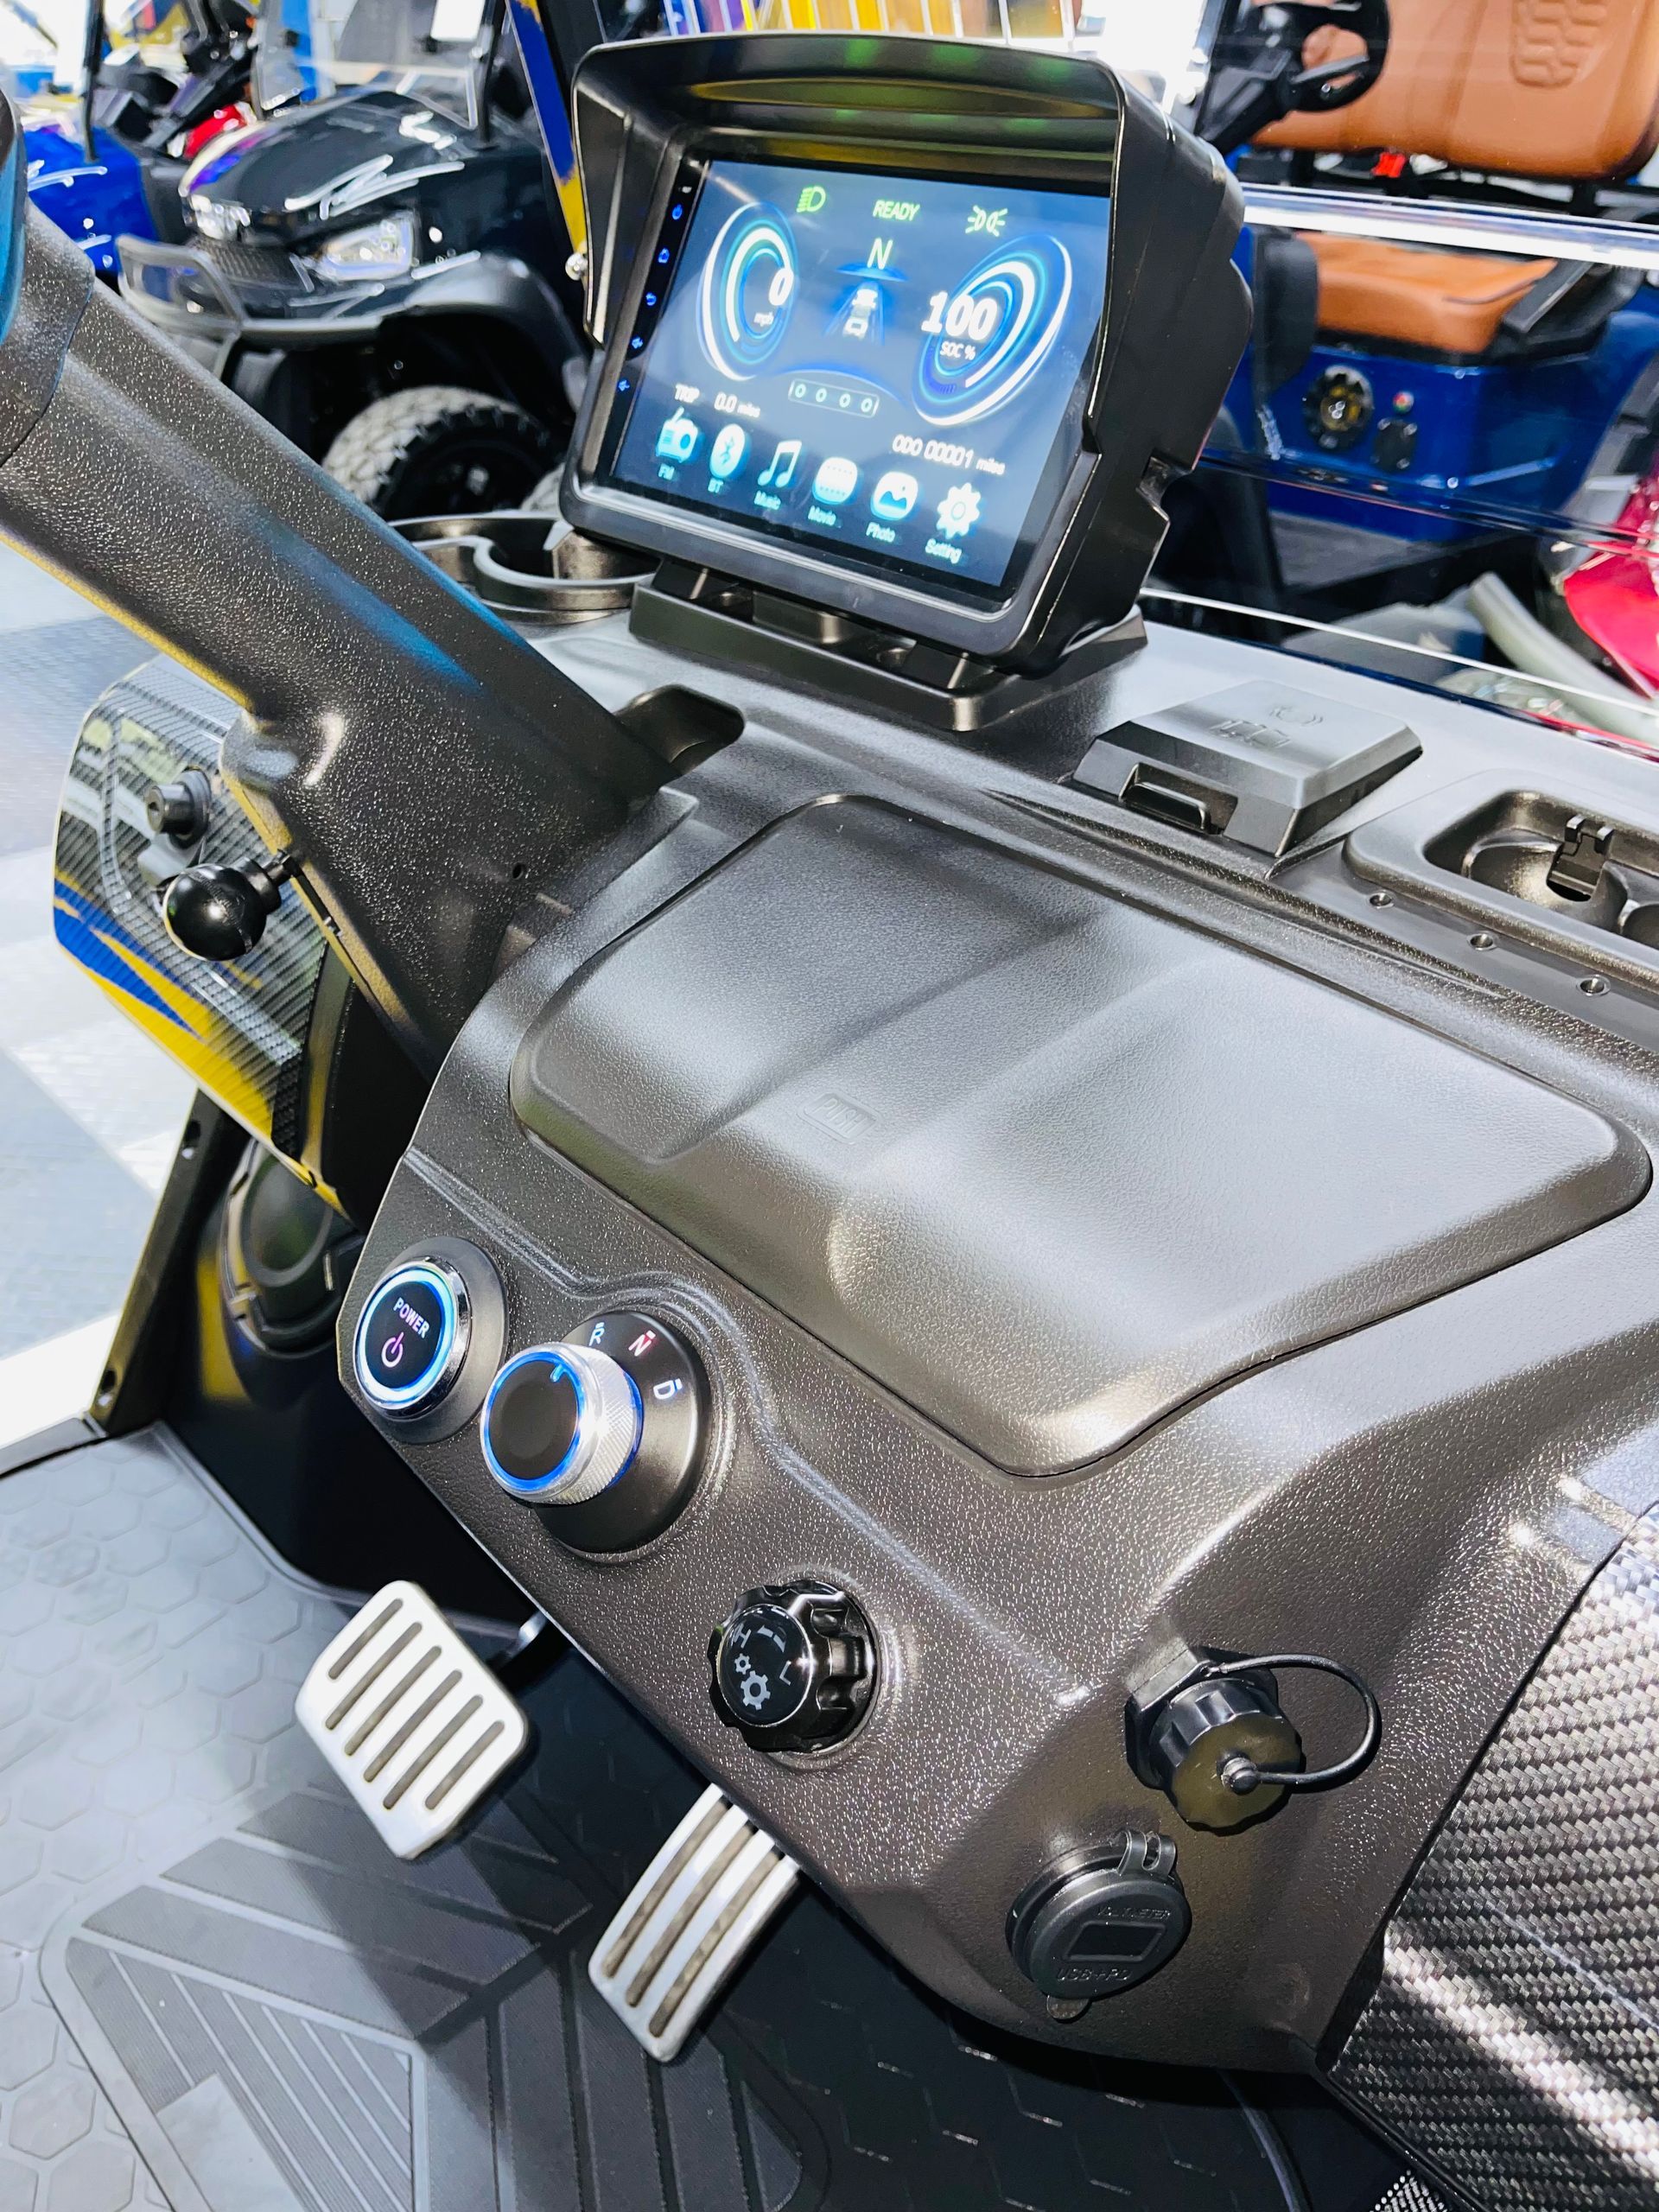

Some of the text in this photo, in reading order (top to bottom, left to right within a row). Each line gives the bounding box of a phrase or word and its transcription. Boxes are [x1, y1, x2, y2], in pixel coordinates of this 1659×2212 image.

[873, 200, 920, 221] READY
[867, 238, 893, 270] N
[768, 267, 794, 306] 0
[921, 290, 998, 340] 100
[940, 340, 964, 358] SOC
[674, 383, 701, 404] TRIP
[714, 391, 738, 413] 0.0
[924, 440, 975, 469] 00001
[976, 458, 1006, 476] miles
[753, 490, 781, 510] Music
[808, 505, 836, 526] Movie
[866, 522, 896, 543] Photo
[925, 537, 963, 564] Setting
[812, 1097, 868, 1134] PUSH
[393, 1297, 430, 1338] POWER
[589, 1327, 604, 1346] R
[628, 1335, 652, 1357] N
[653, 1381, 676, 1400] D
